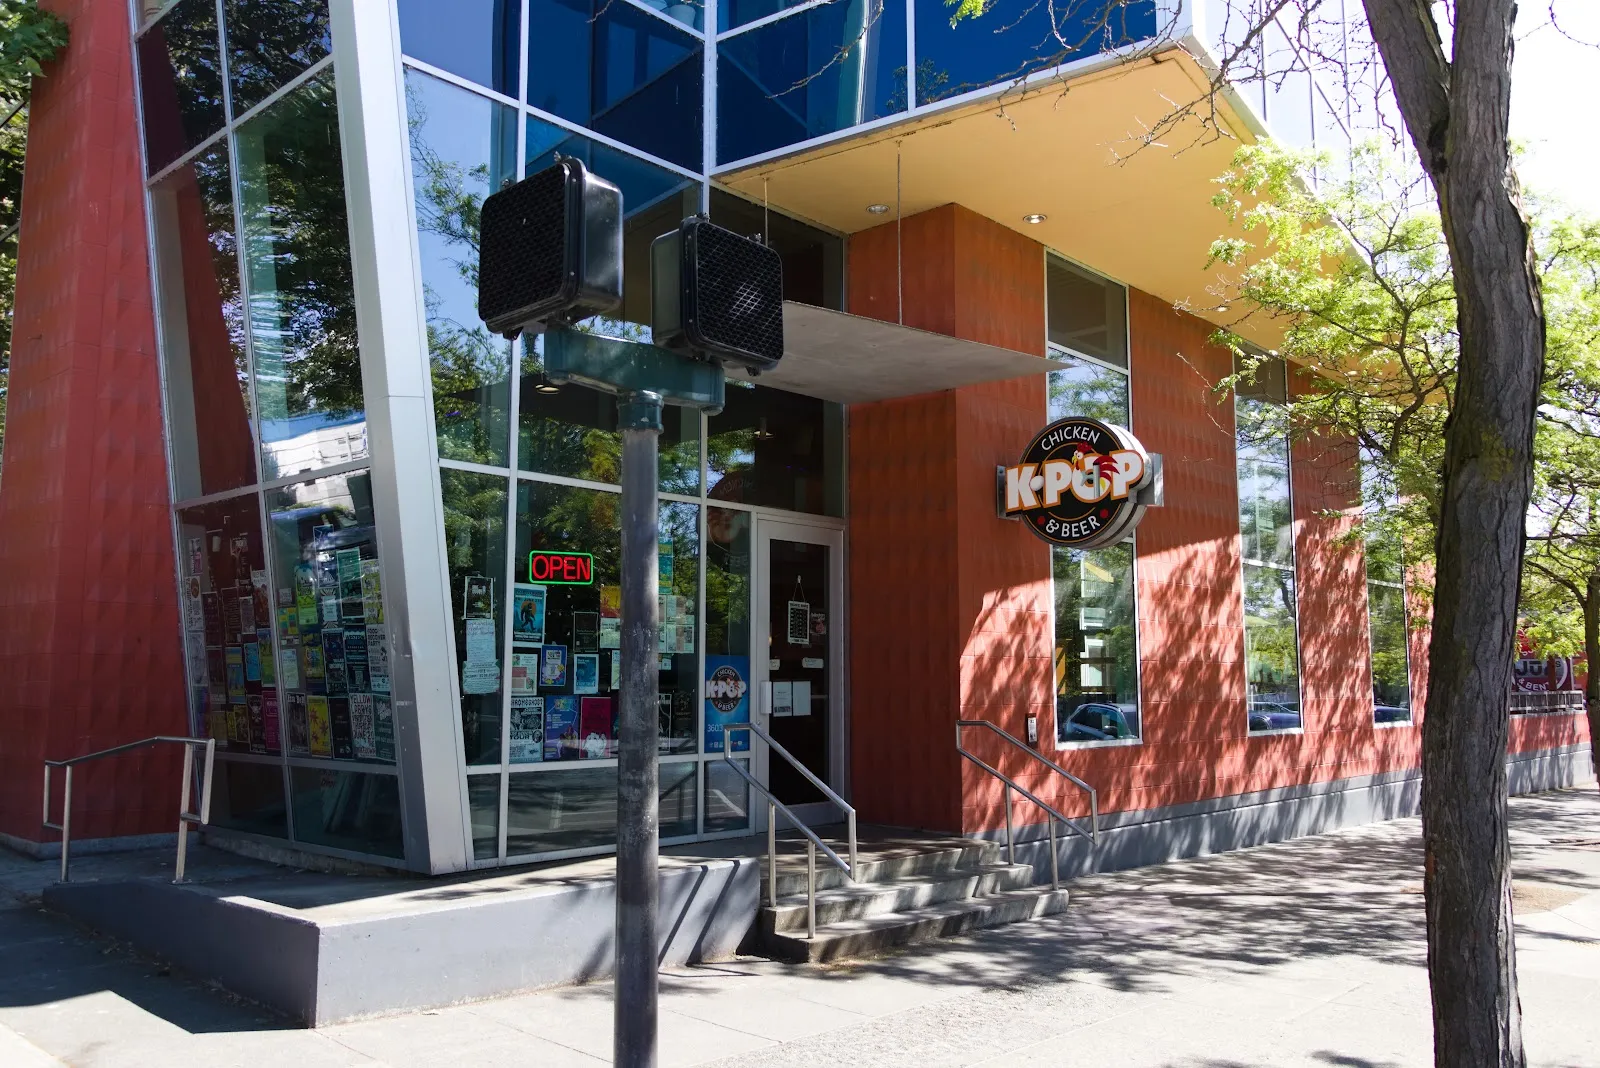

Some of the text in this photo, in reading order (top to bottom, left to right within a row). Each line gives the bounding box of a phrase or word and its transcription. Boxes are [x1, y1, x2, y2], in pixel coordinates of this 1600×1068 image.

[1041, 425, 1101, 451] CHICKEN
[1045, 515, 1101, 537] & BEER
[532, 555, 590, 580] OPEN
[717, 668, 735, 677] CHICKEN
[722, 702, 735, 711] BEER
